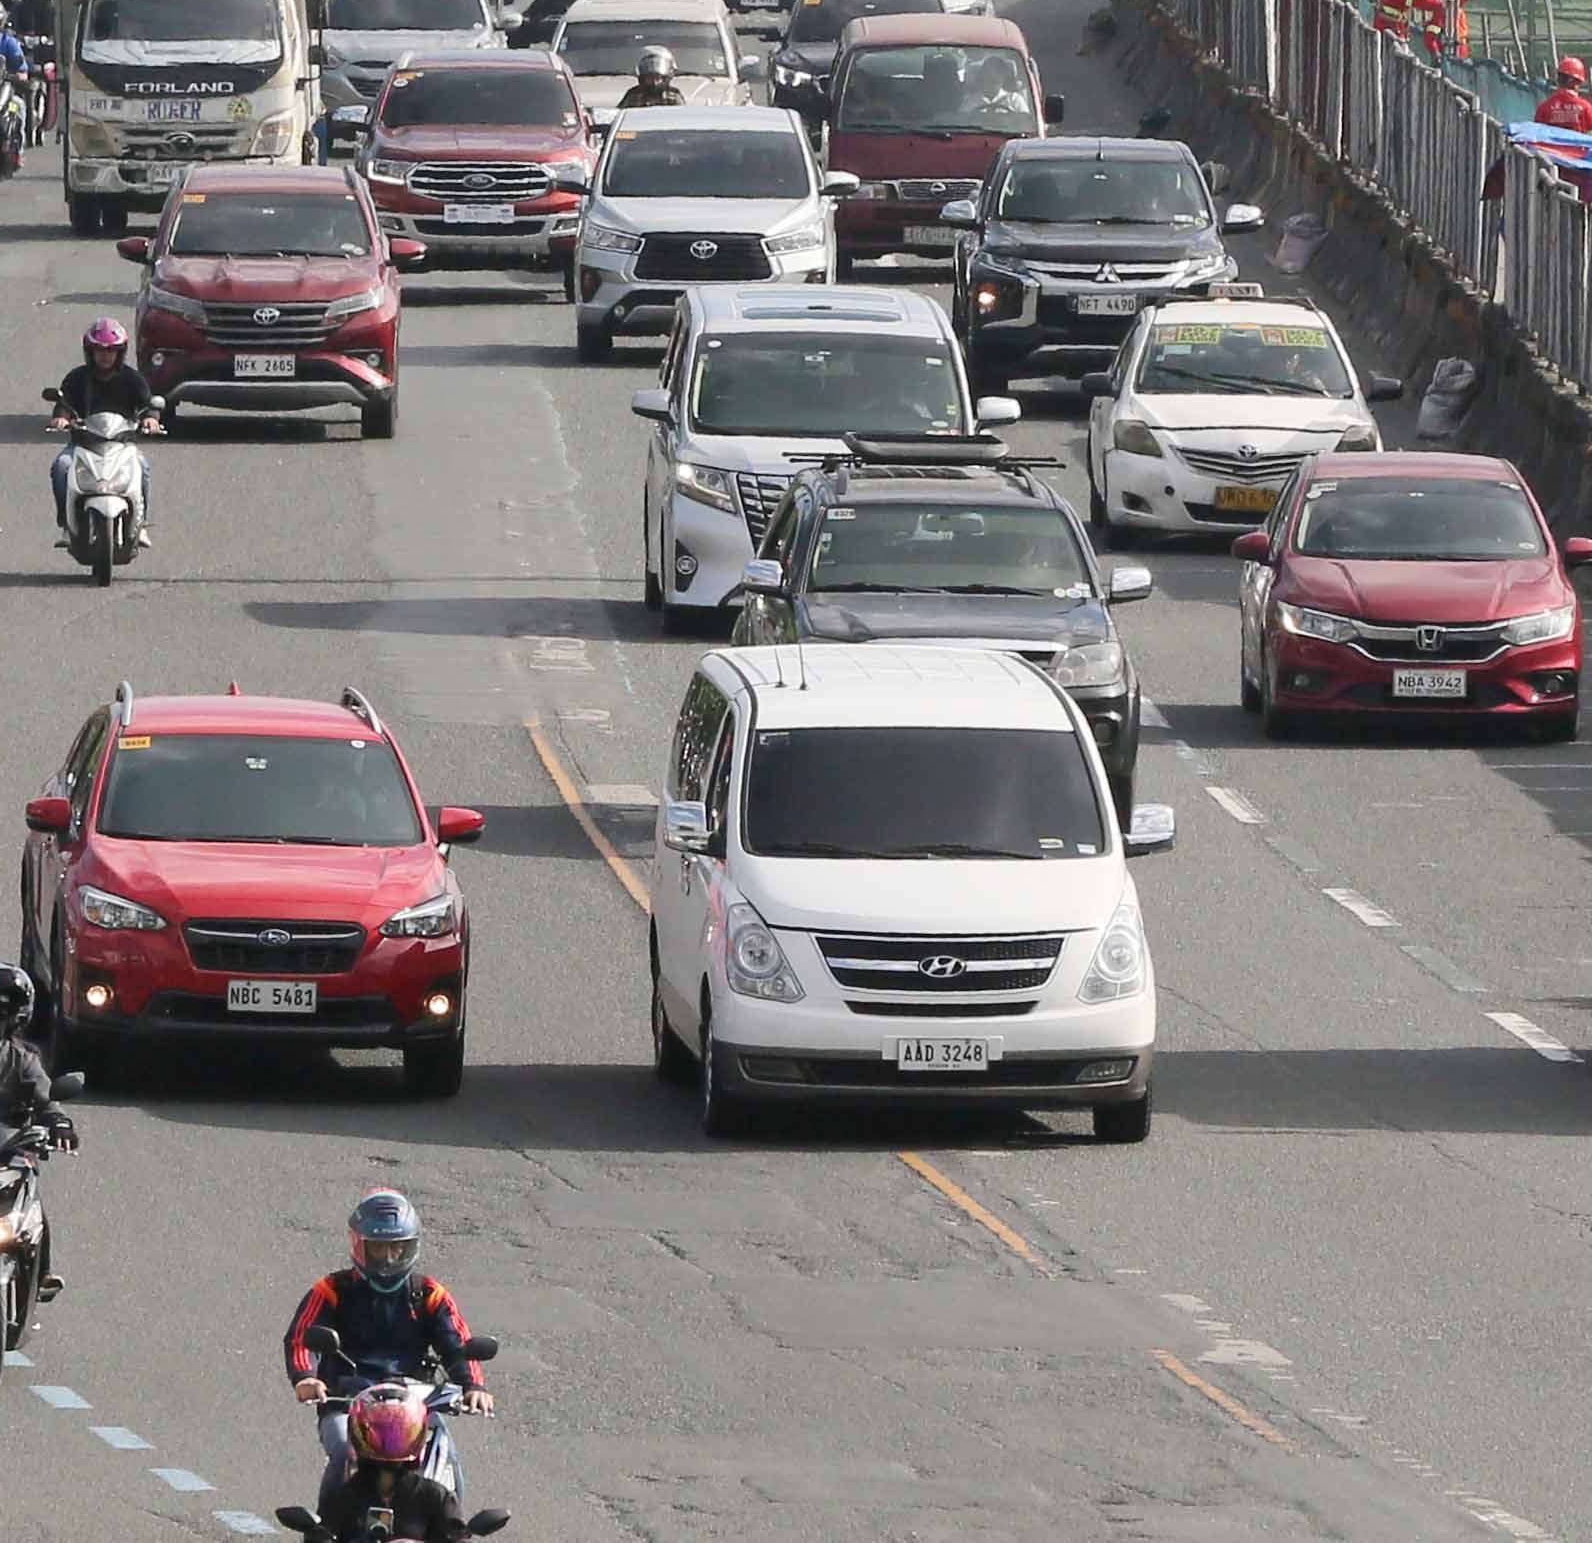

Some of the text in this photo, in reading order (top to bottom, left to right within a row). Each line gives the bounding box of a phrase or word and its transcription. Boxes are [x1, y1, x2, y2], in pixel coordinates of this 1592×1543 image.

[124, 81, 234, 94] FORLAND
[1079, 298, 1135, 312] NFT 4490
[1398, 676, 1462, 688] NBA 3942
[230, 987, 313, 1007] NBC 5481
[904, 1043, 983, 1062] AAD 3248
